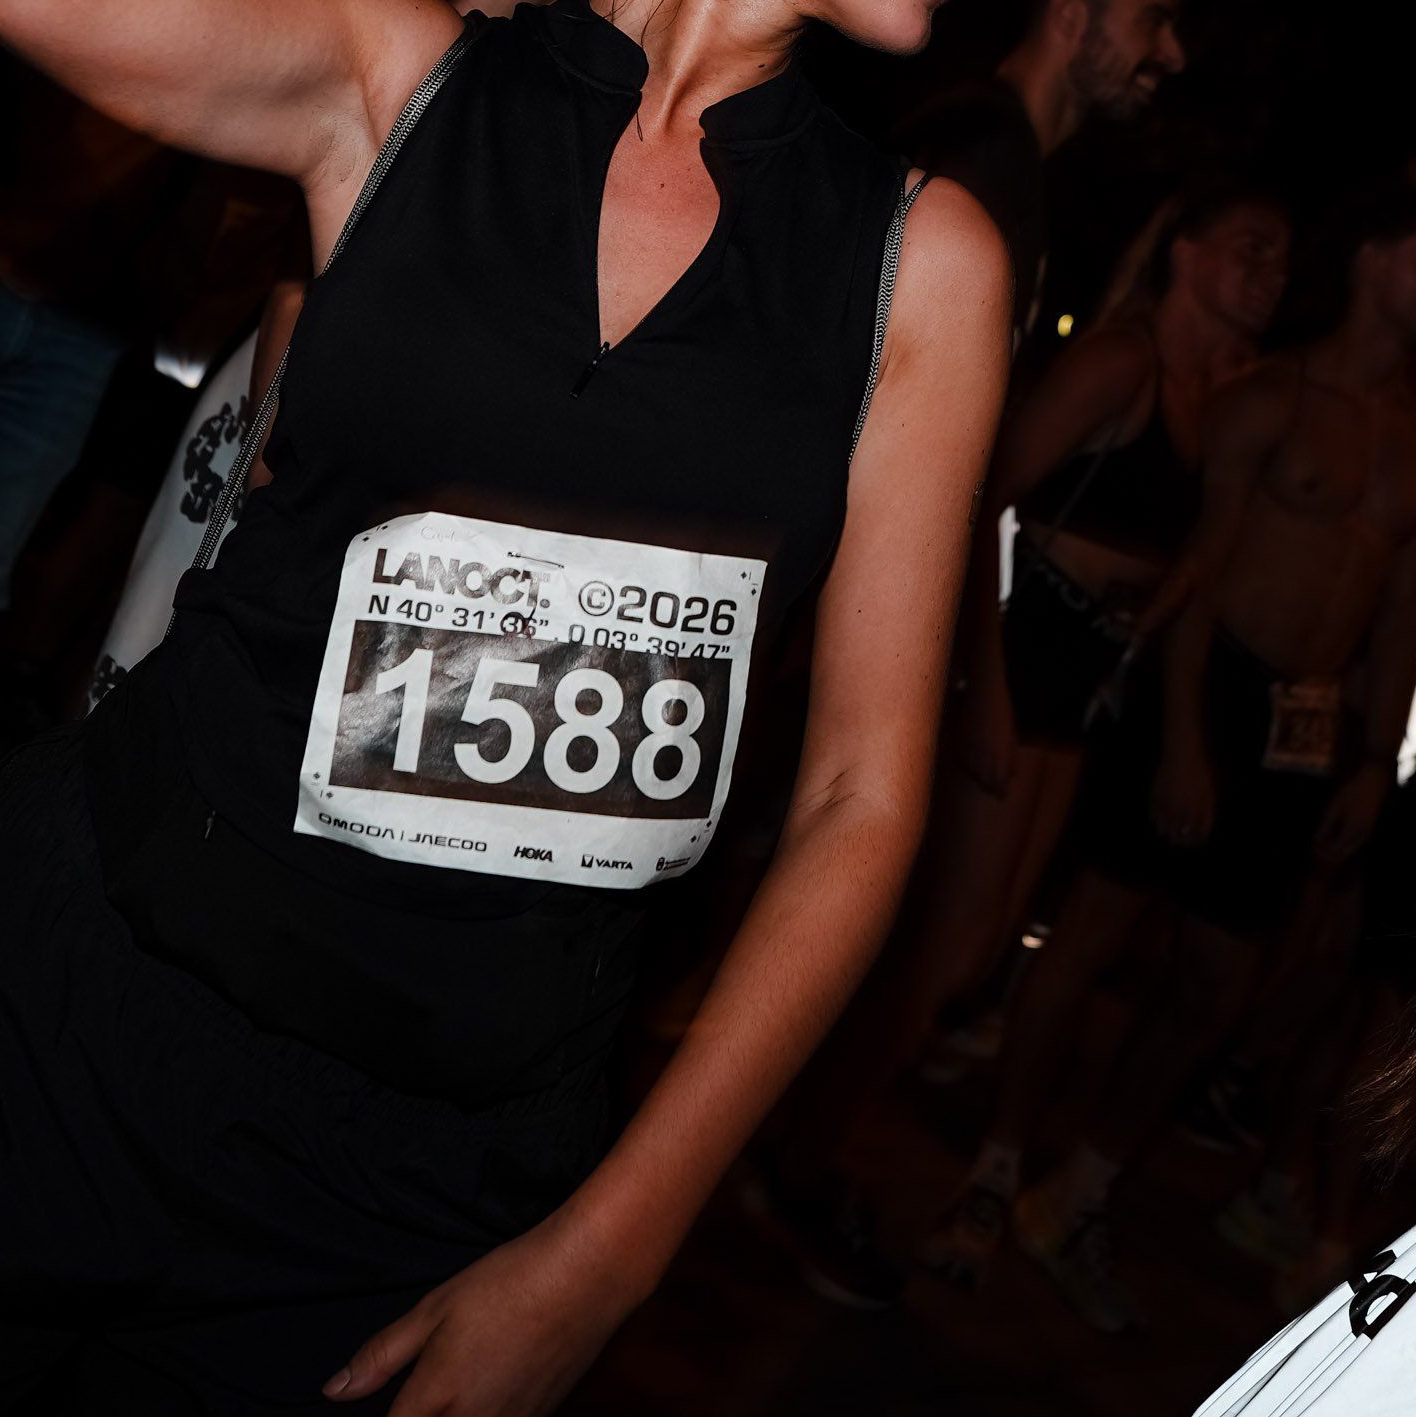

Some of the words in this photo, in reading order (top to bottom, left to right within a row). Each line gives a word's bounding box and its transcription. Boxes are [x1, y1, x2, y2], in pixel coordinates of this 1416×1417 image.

[368, 594, 390, 615] N
[374, 648, 706, 801] 1588
[318, 812, 395, 840] OMODA
[408, 833, 488, 852] JAECOO
[514, 846, 554, 863] HOKA
[595, 858, 634, 870] VARTA
